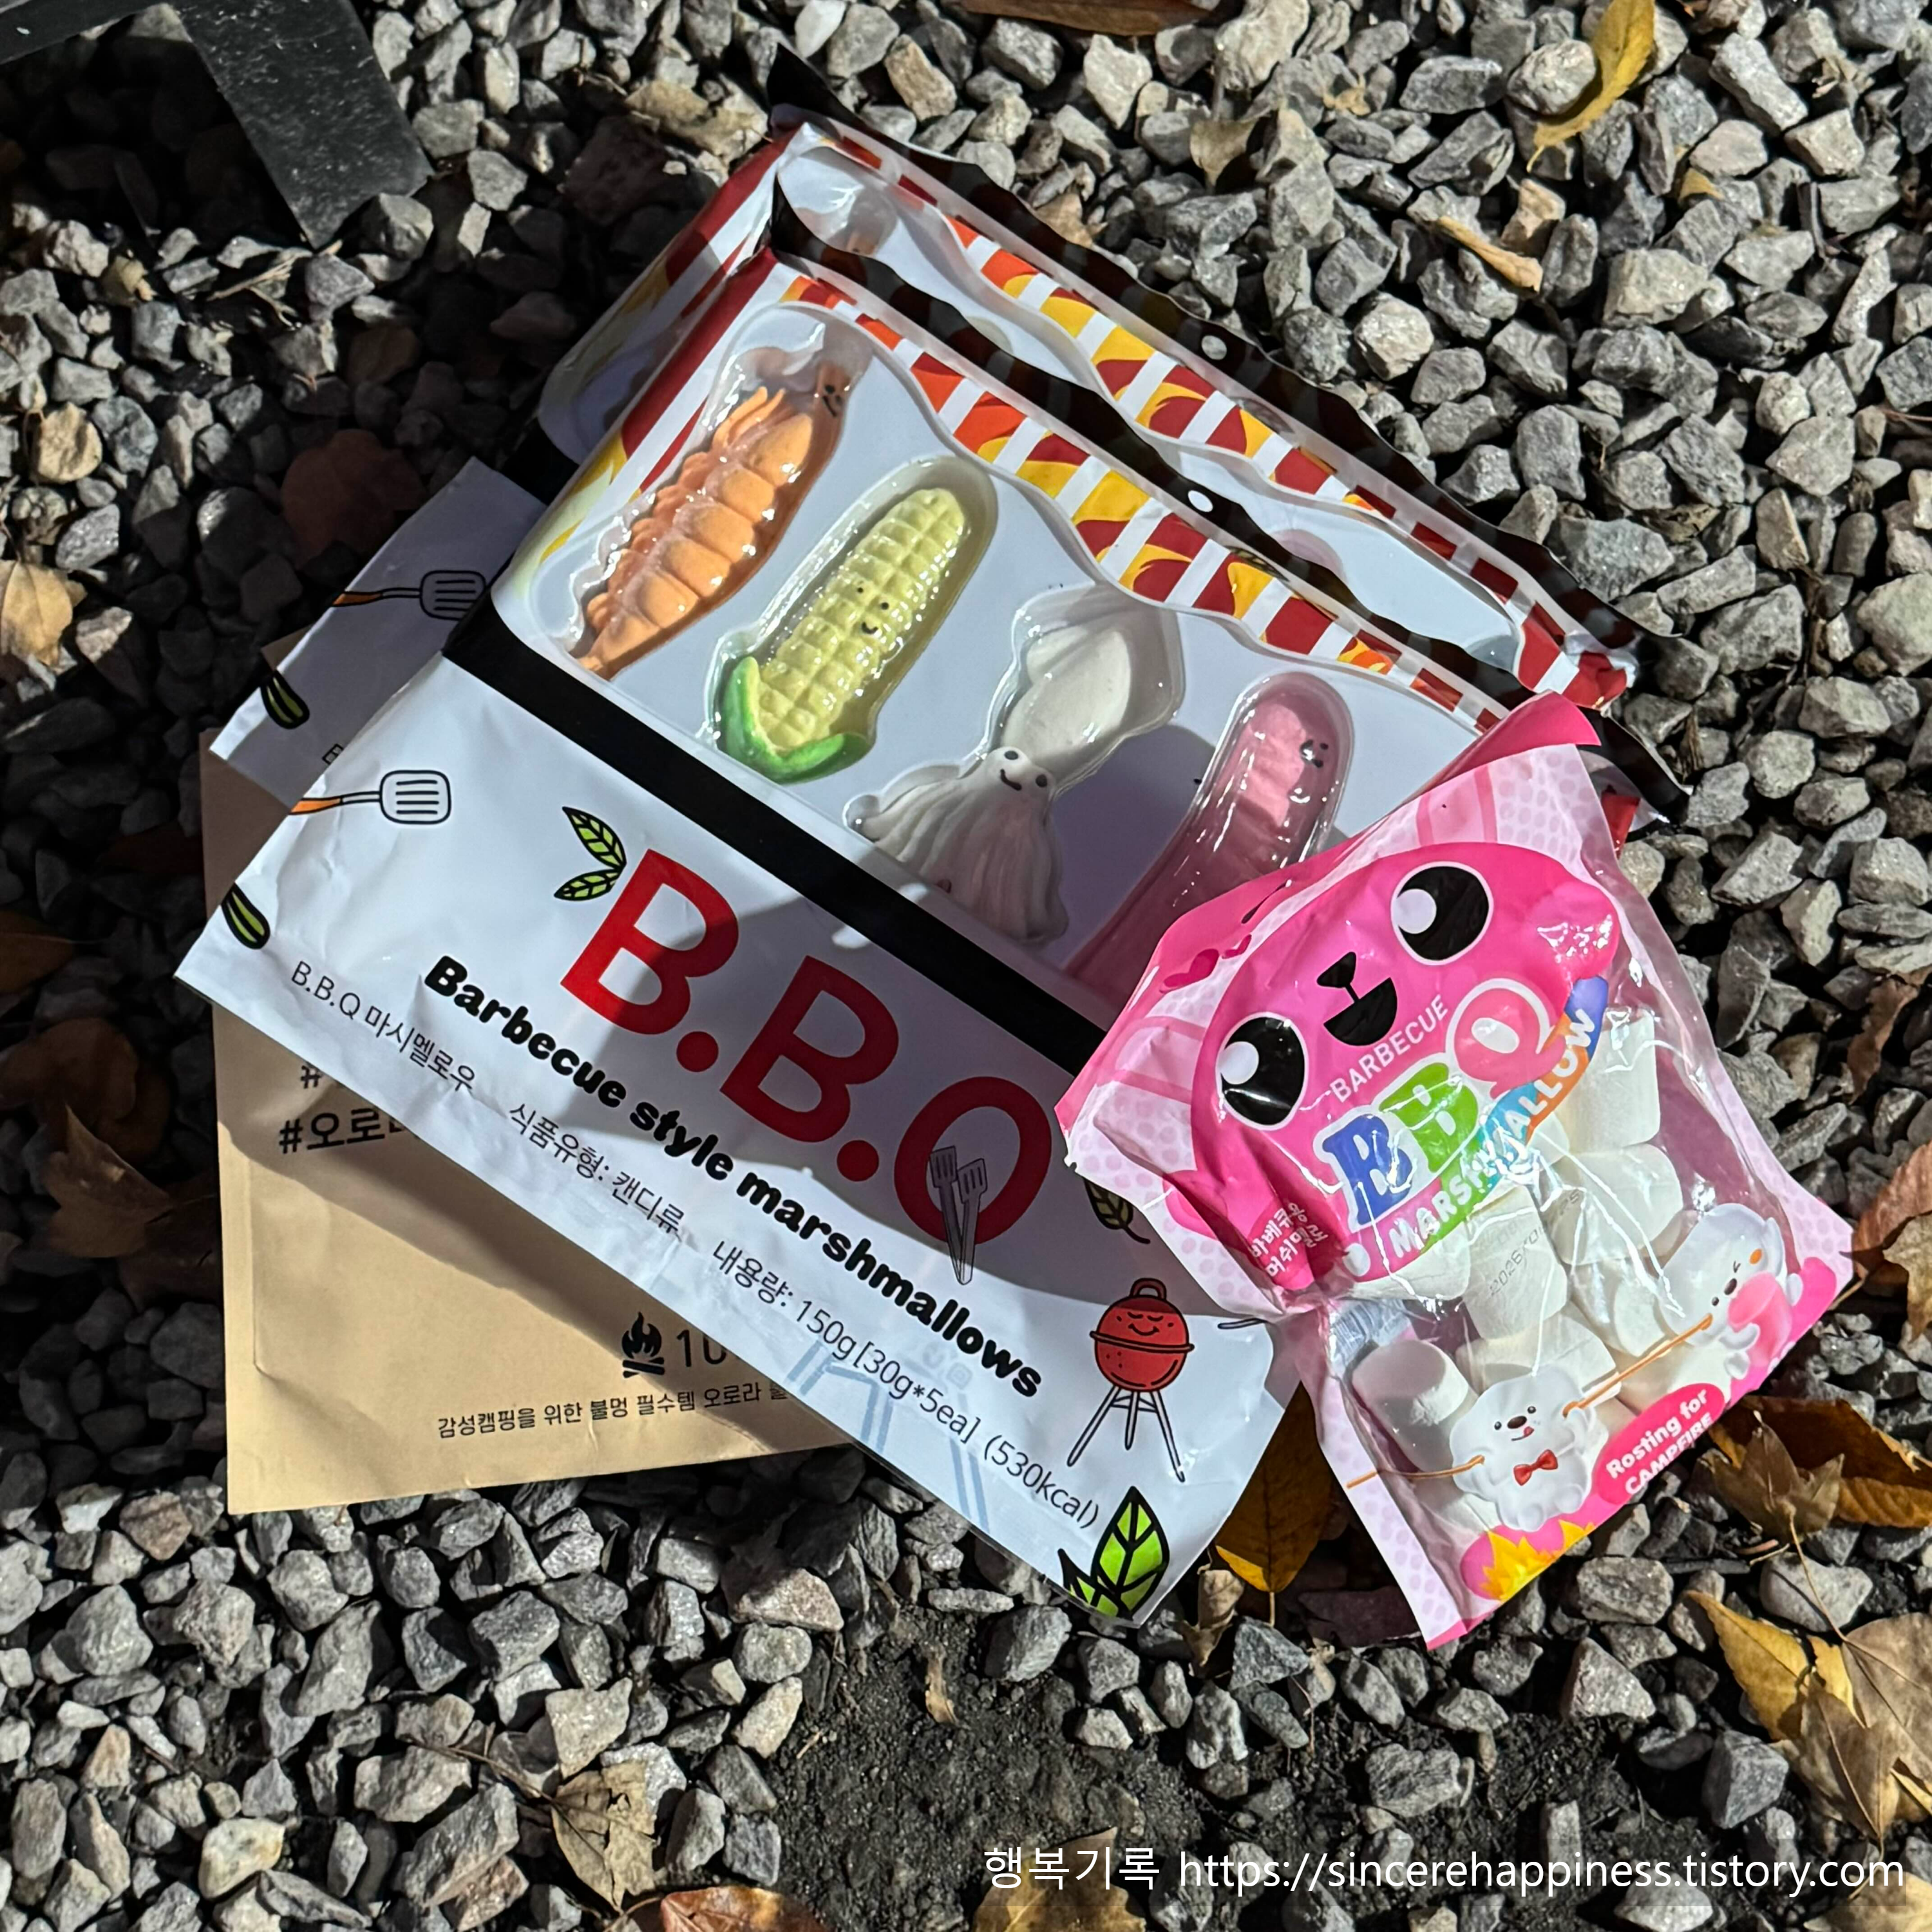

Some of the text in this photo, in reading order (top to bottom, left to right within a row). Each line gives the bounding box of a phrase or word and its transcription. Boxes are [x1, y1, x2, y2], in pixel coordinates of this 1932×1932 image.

[1330, 994, 1449, 1103] BARBECUE
[279, 1108, 407, 1154] #오로
[1317, 984, 1560, 1224] BBQ
[424, 956, 1042, 1397] Barbecue style marshmallows
[291, 961, 361, 1019] B.B.Q
[365, 1005, 476, 1092] 마시멜로우
[509, 1103, 610, 1181] 식품유형:
[612, 1170, 685, 1230] 캔디류
[713, 1240, 794, 1307] 내용량:
[984, 1434, 1099, 1529] (530kcal)
[438, 1406, 536, 1439] 감성캠핑을
[544, 1402, 583, 1426] 위한
[590, 1397, 628, 1421] 불멍
[636, 1390, 695, 1416] 필수템
[704, 1382, 762, 1408] 오로라
[1605, 1389, 1708, 1481] Rosting for
[1625, 1413, 1713, 1495] CAMPFIRE
